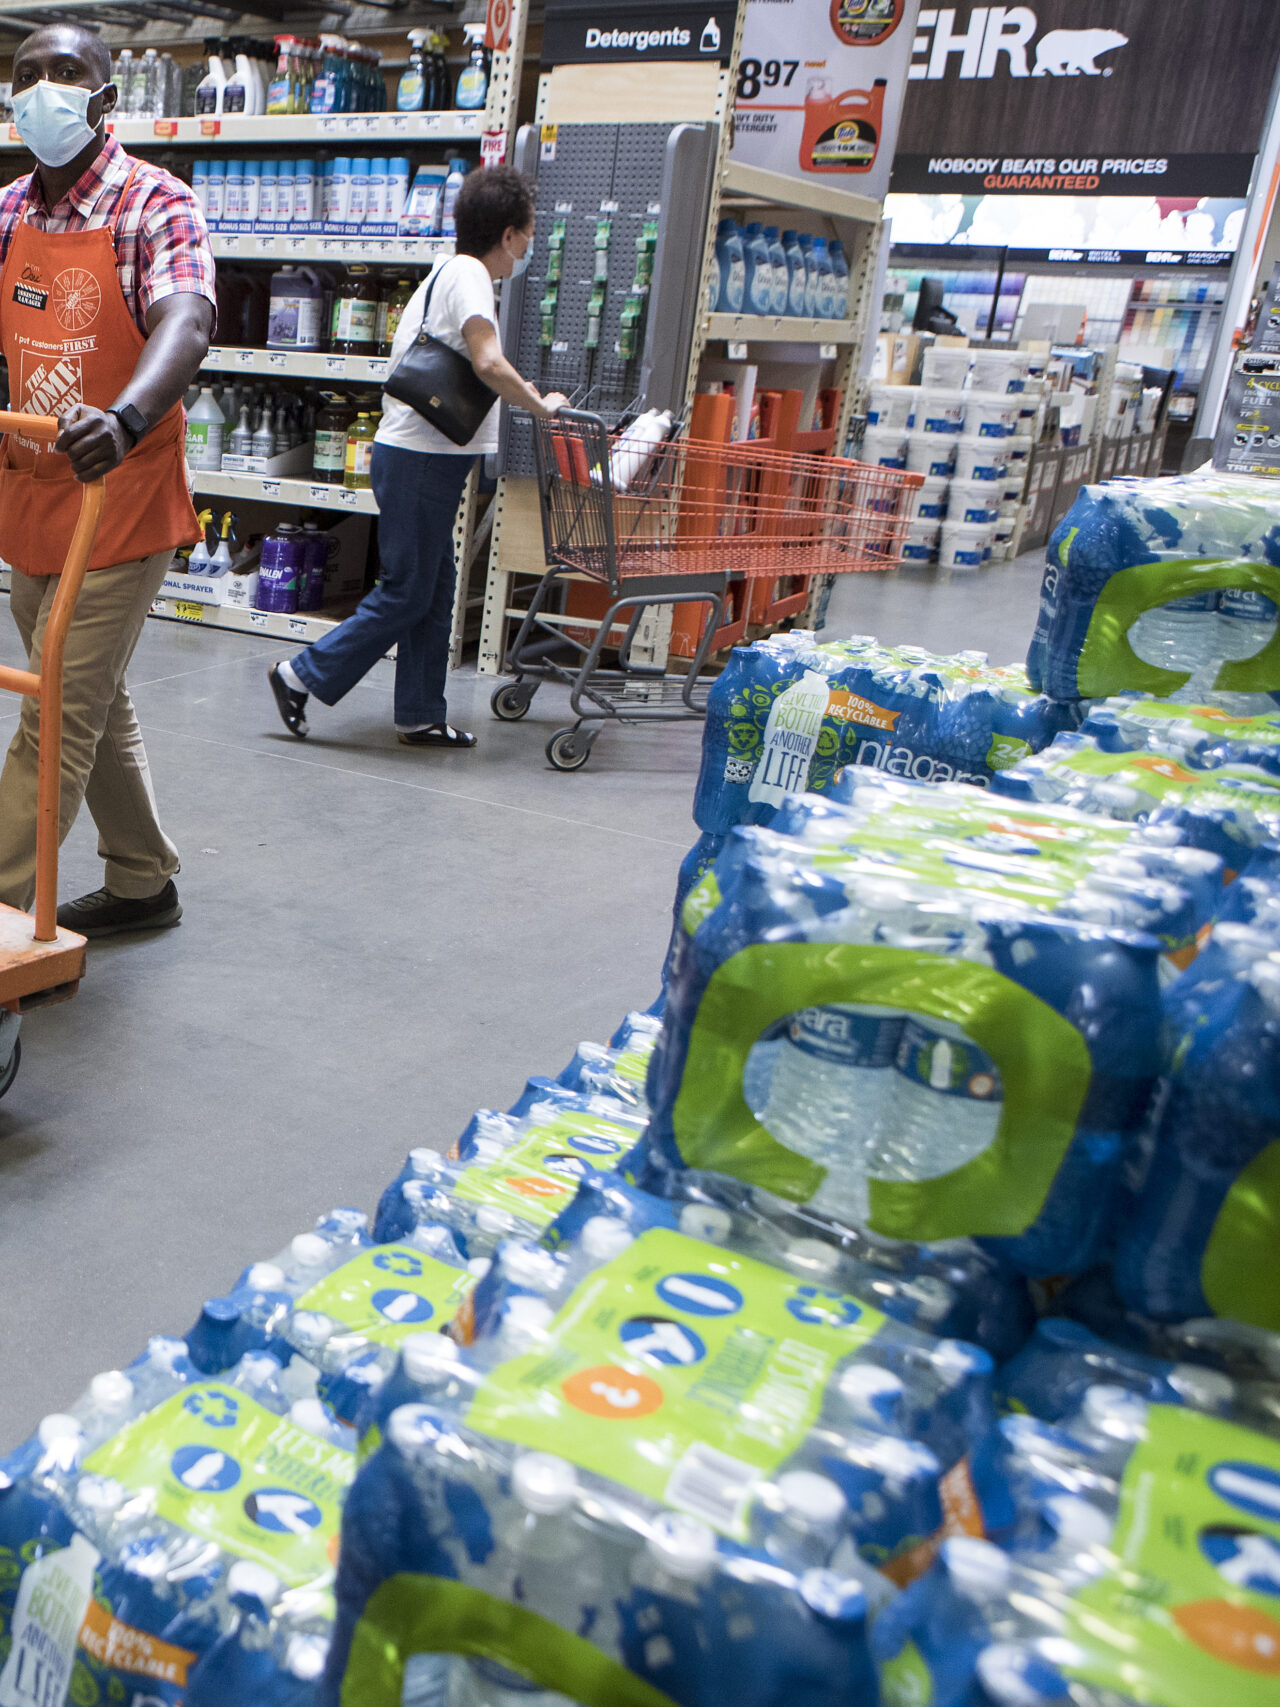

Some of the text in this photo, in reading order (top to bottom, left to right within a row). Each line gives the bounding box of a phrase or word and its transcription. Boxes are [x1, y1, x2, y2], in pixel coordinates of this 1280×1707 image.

[585, 26, 691, 50] Detergents
[908, 7, 1037, 80] EHR
[753, 114, 775, 123] DUTY
[483, 139, 503, 152] FIRE
[928, 158, 1168, 174] NOBODY BEATS OUR PRICES
[984, 175, 1100, 189] GUARANTEED
[324, 223, 358, 233] BONUS SIZE
[361, 224, 396, 233] BONUS SIZE
[14, 332, 96, 352] I put customers FIRST
[20, 357, 82, 416] HOME
[24, 363, 48, 394] THE
[1242, 396, 1272, 406] FUEL
[1226, 463, 1280, 473] TRUFUE
[182, 583, 214, 594] SPRAYER
[846, 695, 875, 715] 100%
[774, 707, 820, 737] BOTTLE
[827, 703, 889, 729] RECYCLABLE
[771, 731, 811, 755] ANOTHER
[996, 743, 1028, 759] 24
[856, 738, 992, 790] niagara
